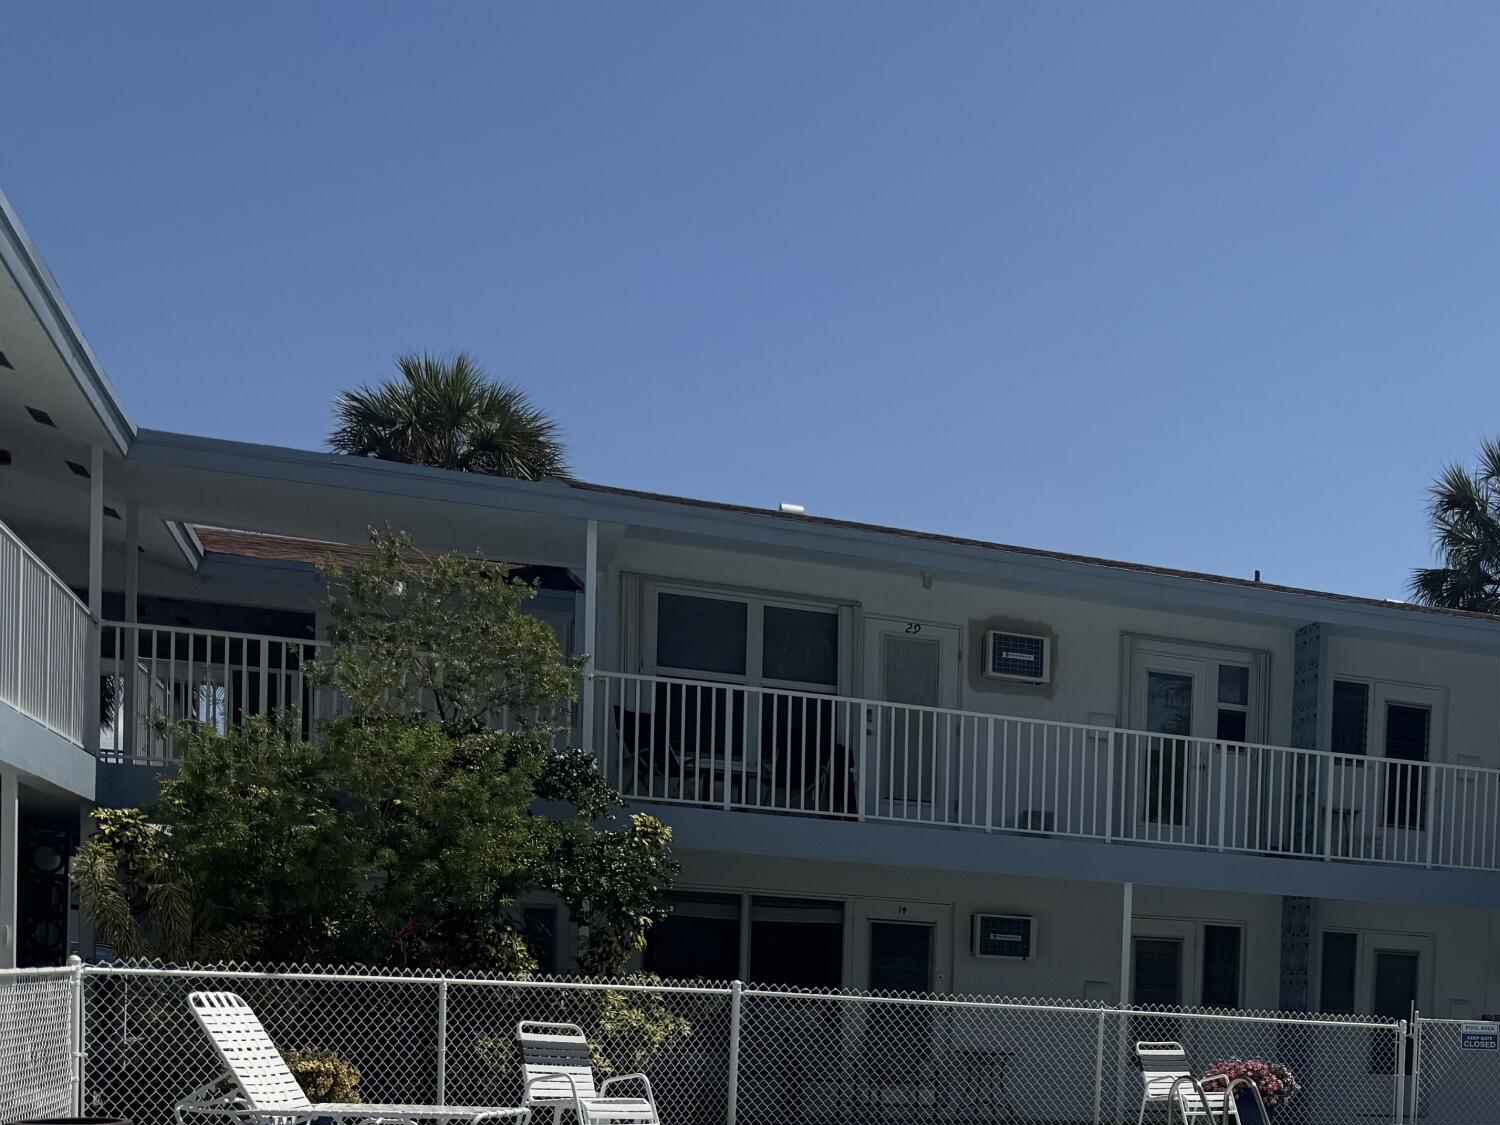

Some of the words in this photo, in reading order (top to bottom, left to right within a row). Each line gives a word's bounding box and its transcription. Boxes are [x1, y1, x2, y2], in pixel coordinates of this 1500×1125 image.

[905, 623, 921, 634] 29
[898, 906, 908, 914] 14
[1463, 1040, 1496, 1048] CLOSED
